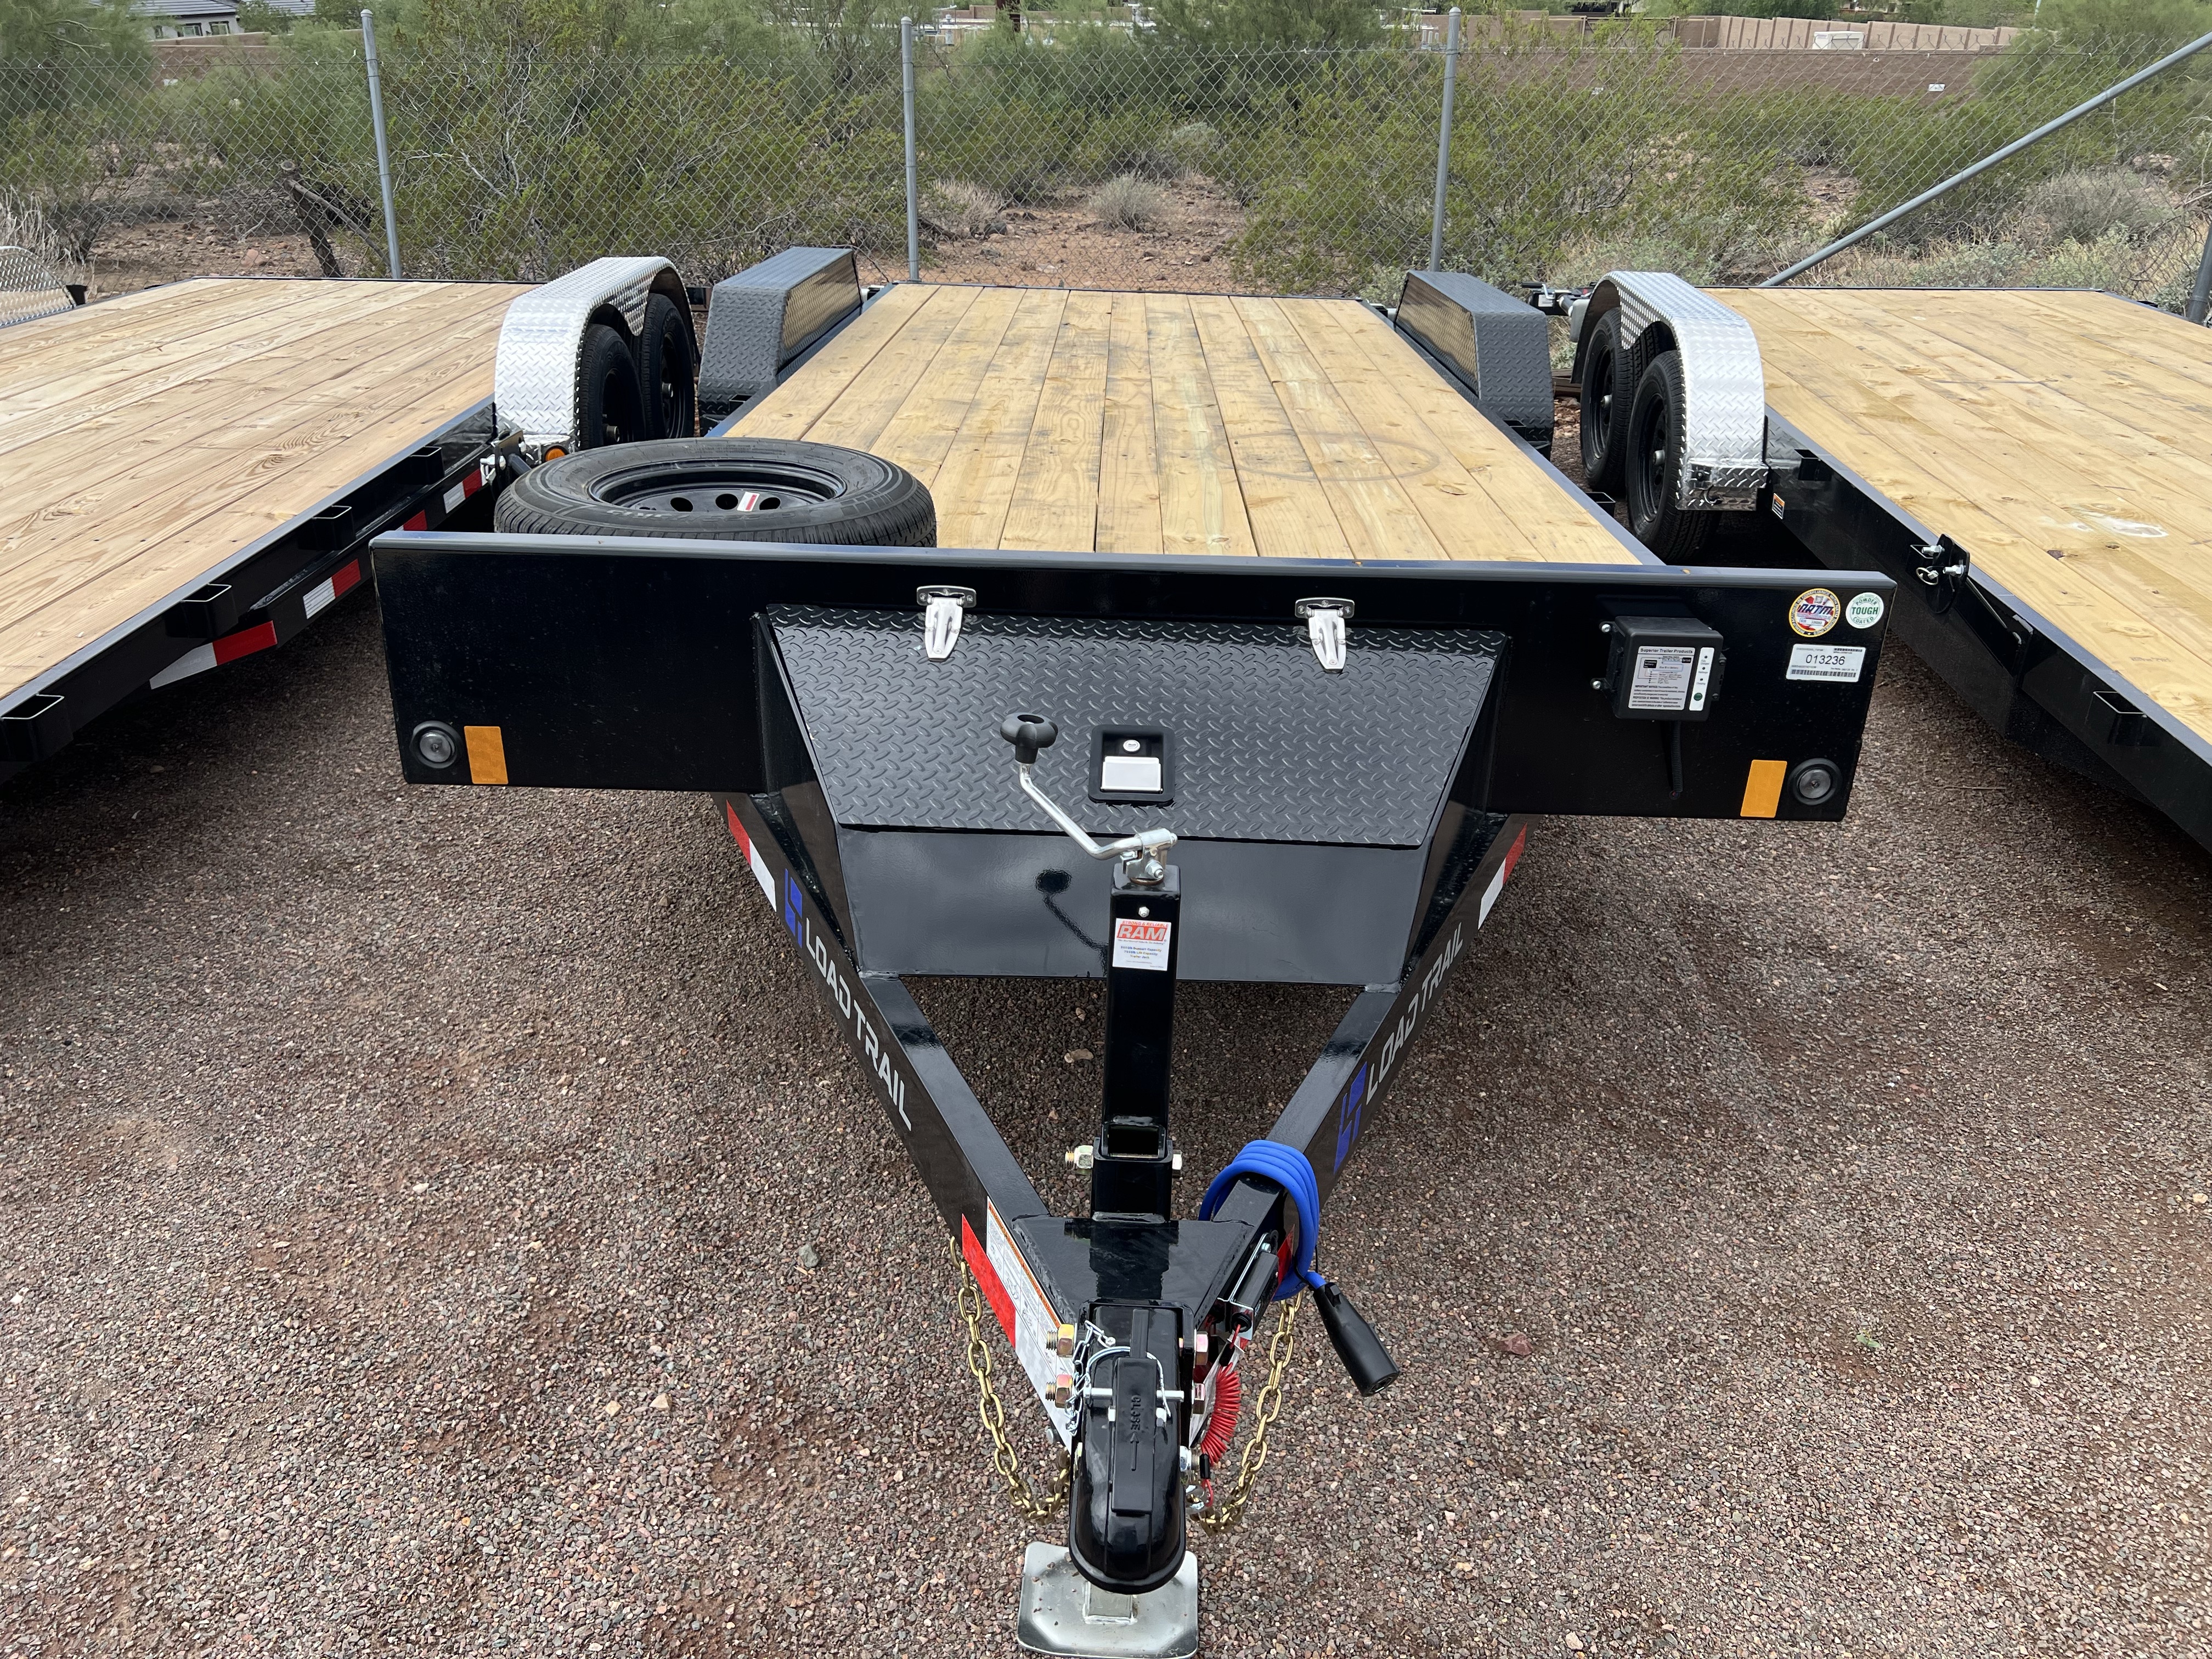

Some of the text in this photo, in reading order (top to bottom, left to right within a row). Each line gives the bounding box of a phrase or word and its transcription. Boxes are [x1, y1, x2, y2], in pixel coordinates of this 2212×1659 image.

[1855, 597, 1877, 606] POWDER
[1852, 607, 1878, 615] TOUGH
[1805, 654, 1846, 665] 013236
[1119, 925, 1166, 940] RAM
[1366, 922, 1464, 1106] LOAD TRAIL
[805, 917, 912, 1131] LOAD TRAIL
[1130, 1394, 1142, 1431] CLOSE
